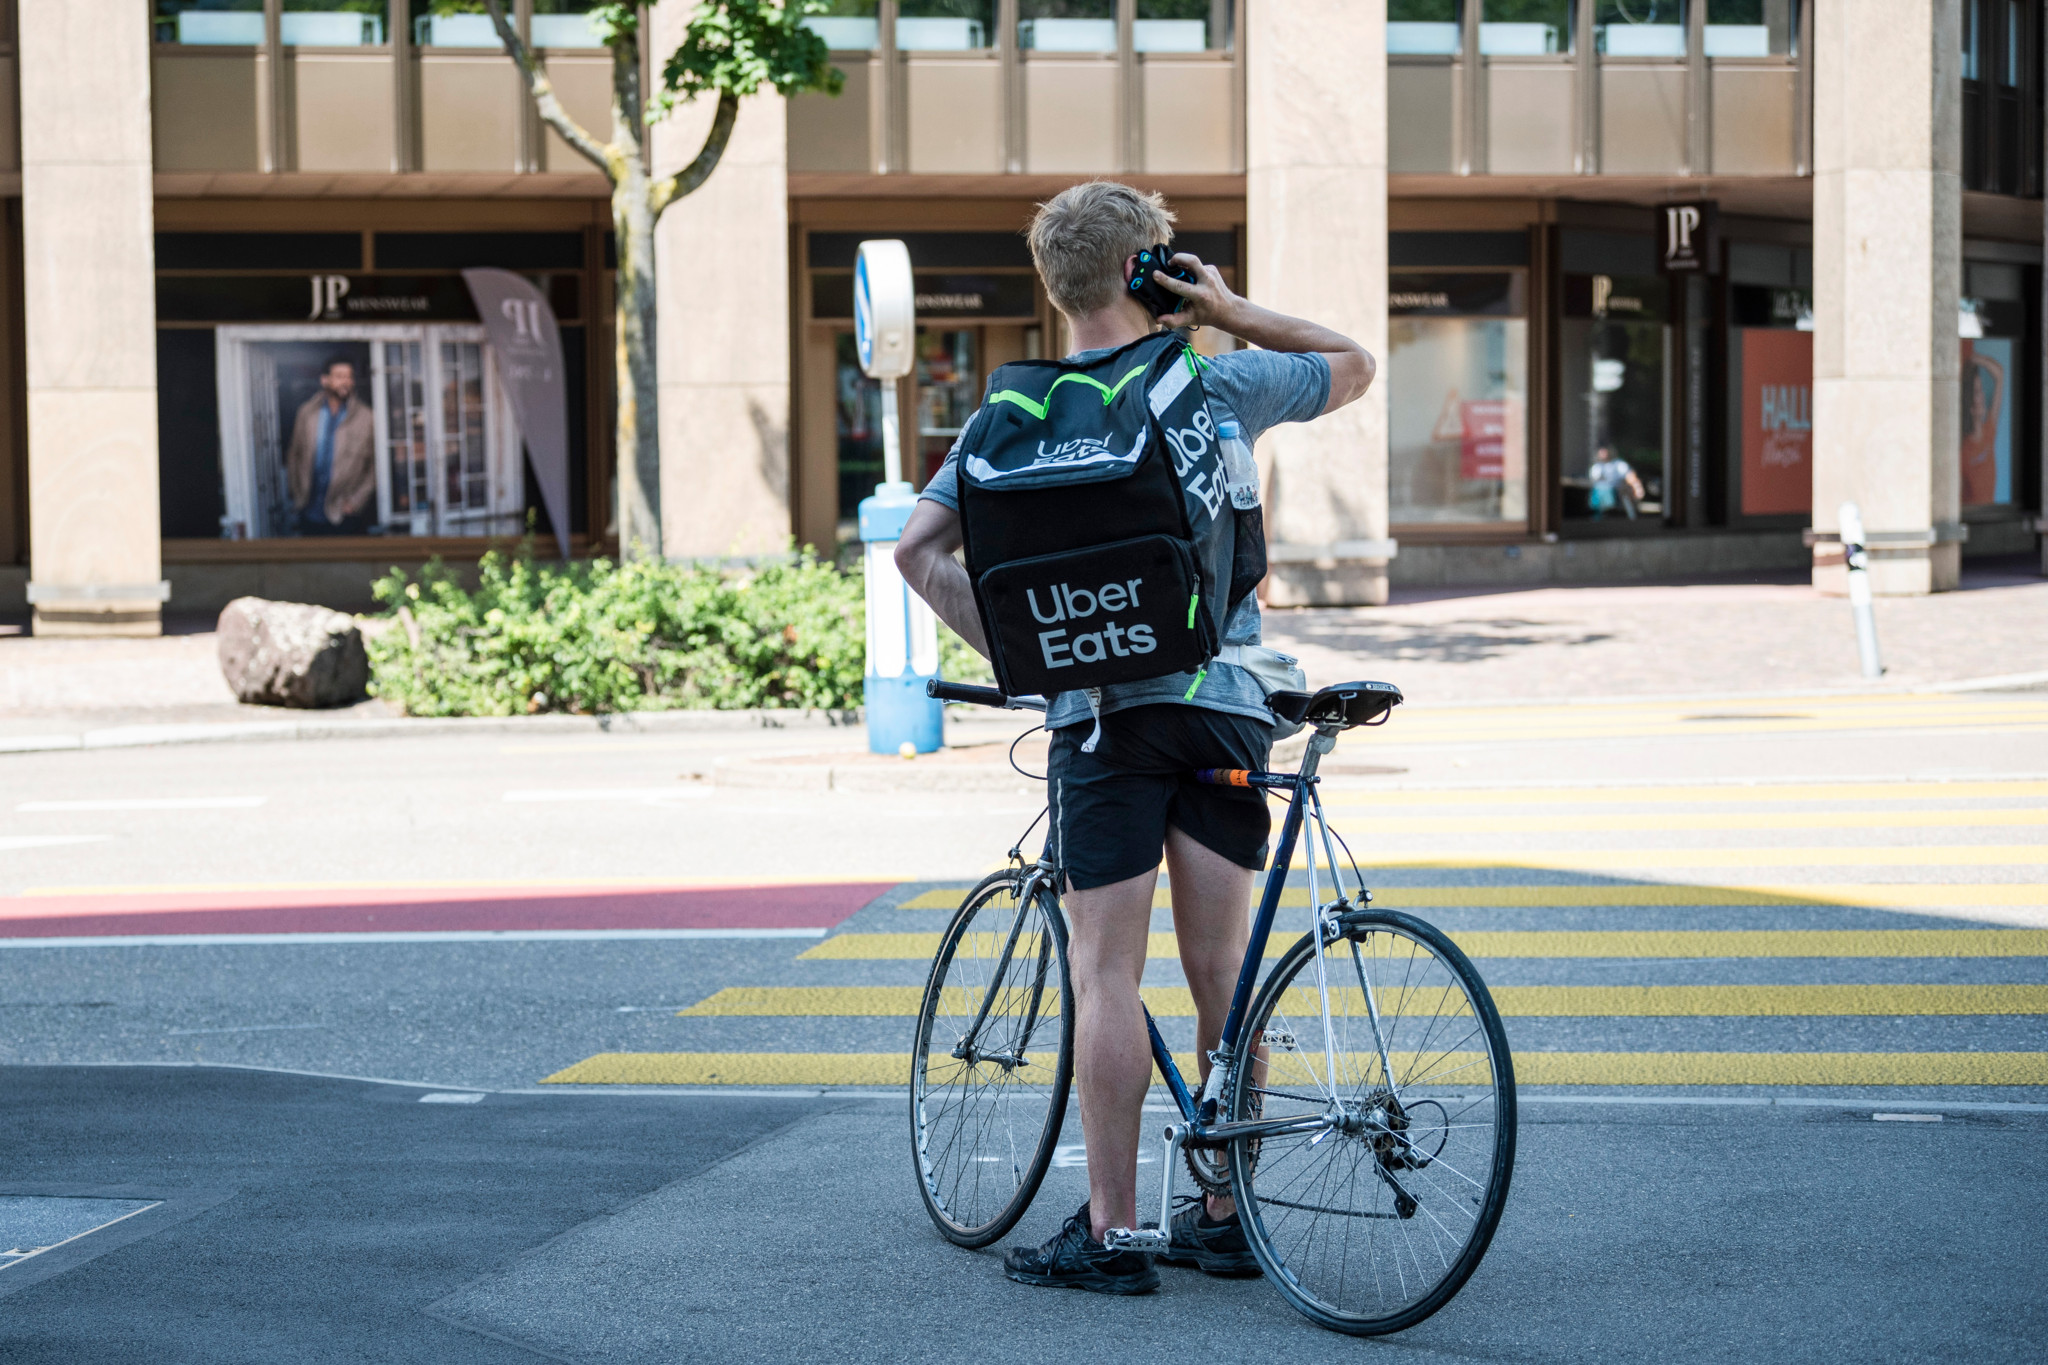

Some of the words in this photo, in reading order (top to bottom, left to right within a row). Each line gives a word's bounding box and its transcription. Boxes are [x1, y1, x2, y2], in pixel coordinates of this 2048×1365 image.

[1666, 206, 1700, 260] JP
[308, 275, 350, 321] JP
[1761, 385, 1812, 431] HALL
[1186, 453, 1230, 521] Eat
[1026, 578, 1143, 624] Uber
[1038, 622, 1157, 669] Eats
